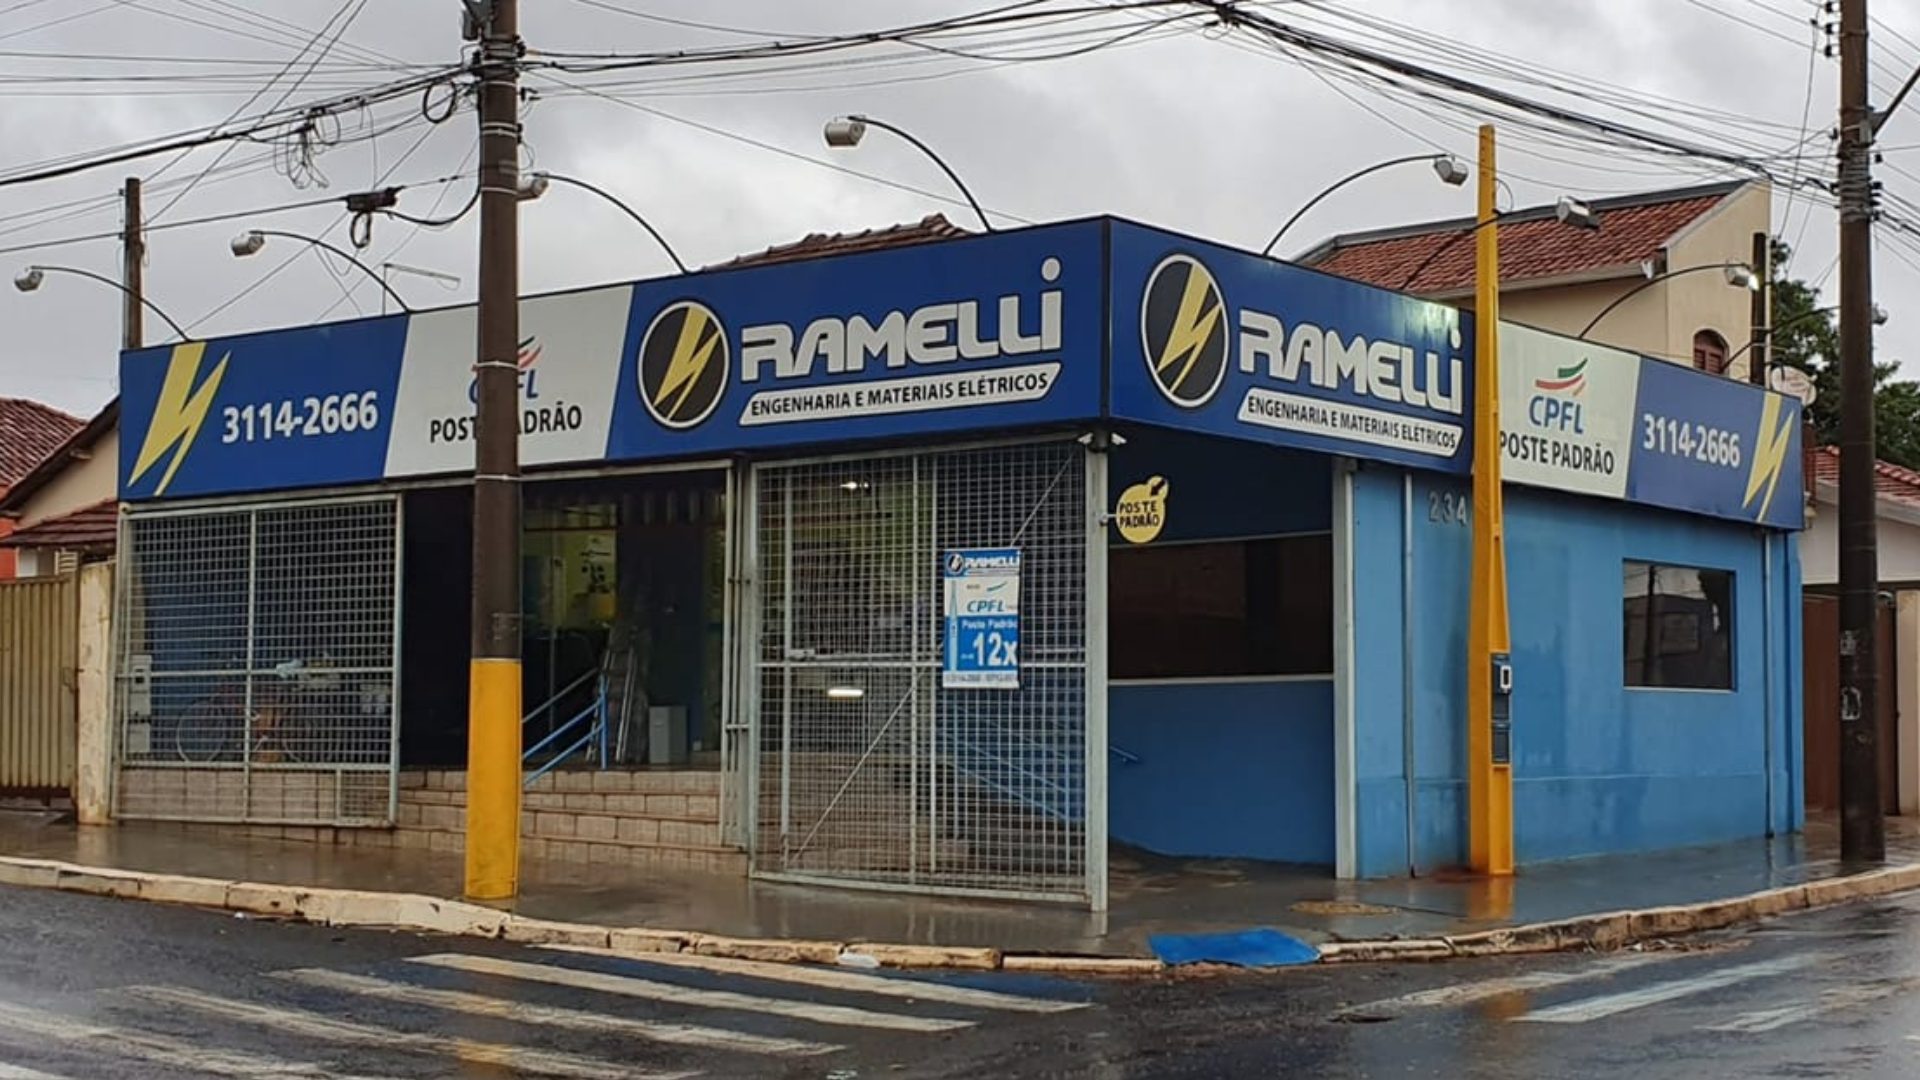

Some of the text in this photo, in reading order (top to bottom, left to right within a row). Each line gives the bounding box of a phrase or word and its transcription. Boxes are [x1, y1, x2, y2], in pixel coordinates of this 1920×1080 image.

[751, 372, 1048, 417] ENGENHARIA E MATERIAIS ELÉTRICOS
[222, 391, 378, 444] 3114-2666
[430, 416, 478, 444] POST
[1248, 396, 1456, 449] ENGENHARIA E MATERIAIS ELÉTRICOS
[1529, 396, 1583, 434] CPFL
[1500, 431, 1614, 475] POSTE PADRÃO
[1643, 414, 1740, 468] 3114-2666
[1120, 501, 1156, 513] POSTE
[1429, 491, 1467, 523] 234
[967, 600, 1004, 612] CPFL
[973, 631, 1017, 667] 12x
